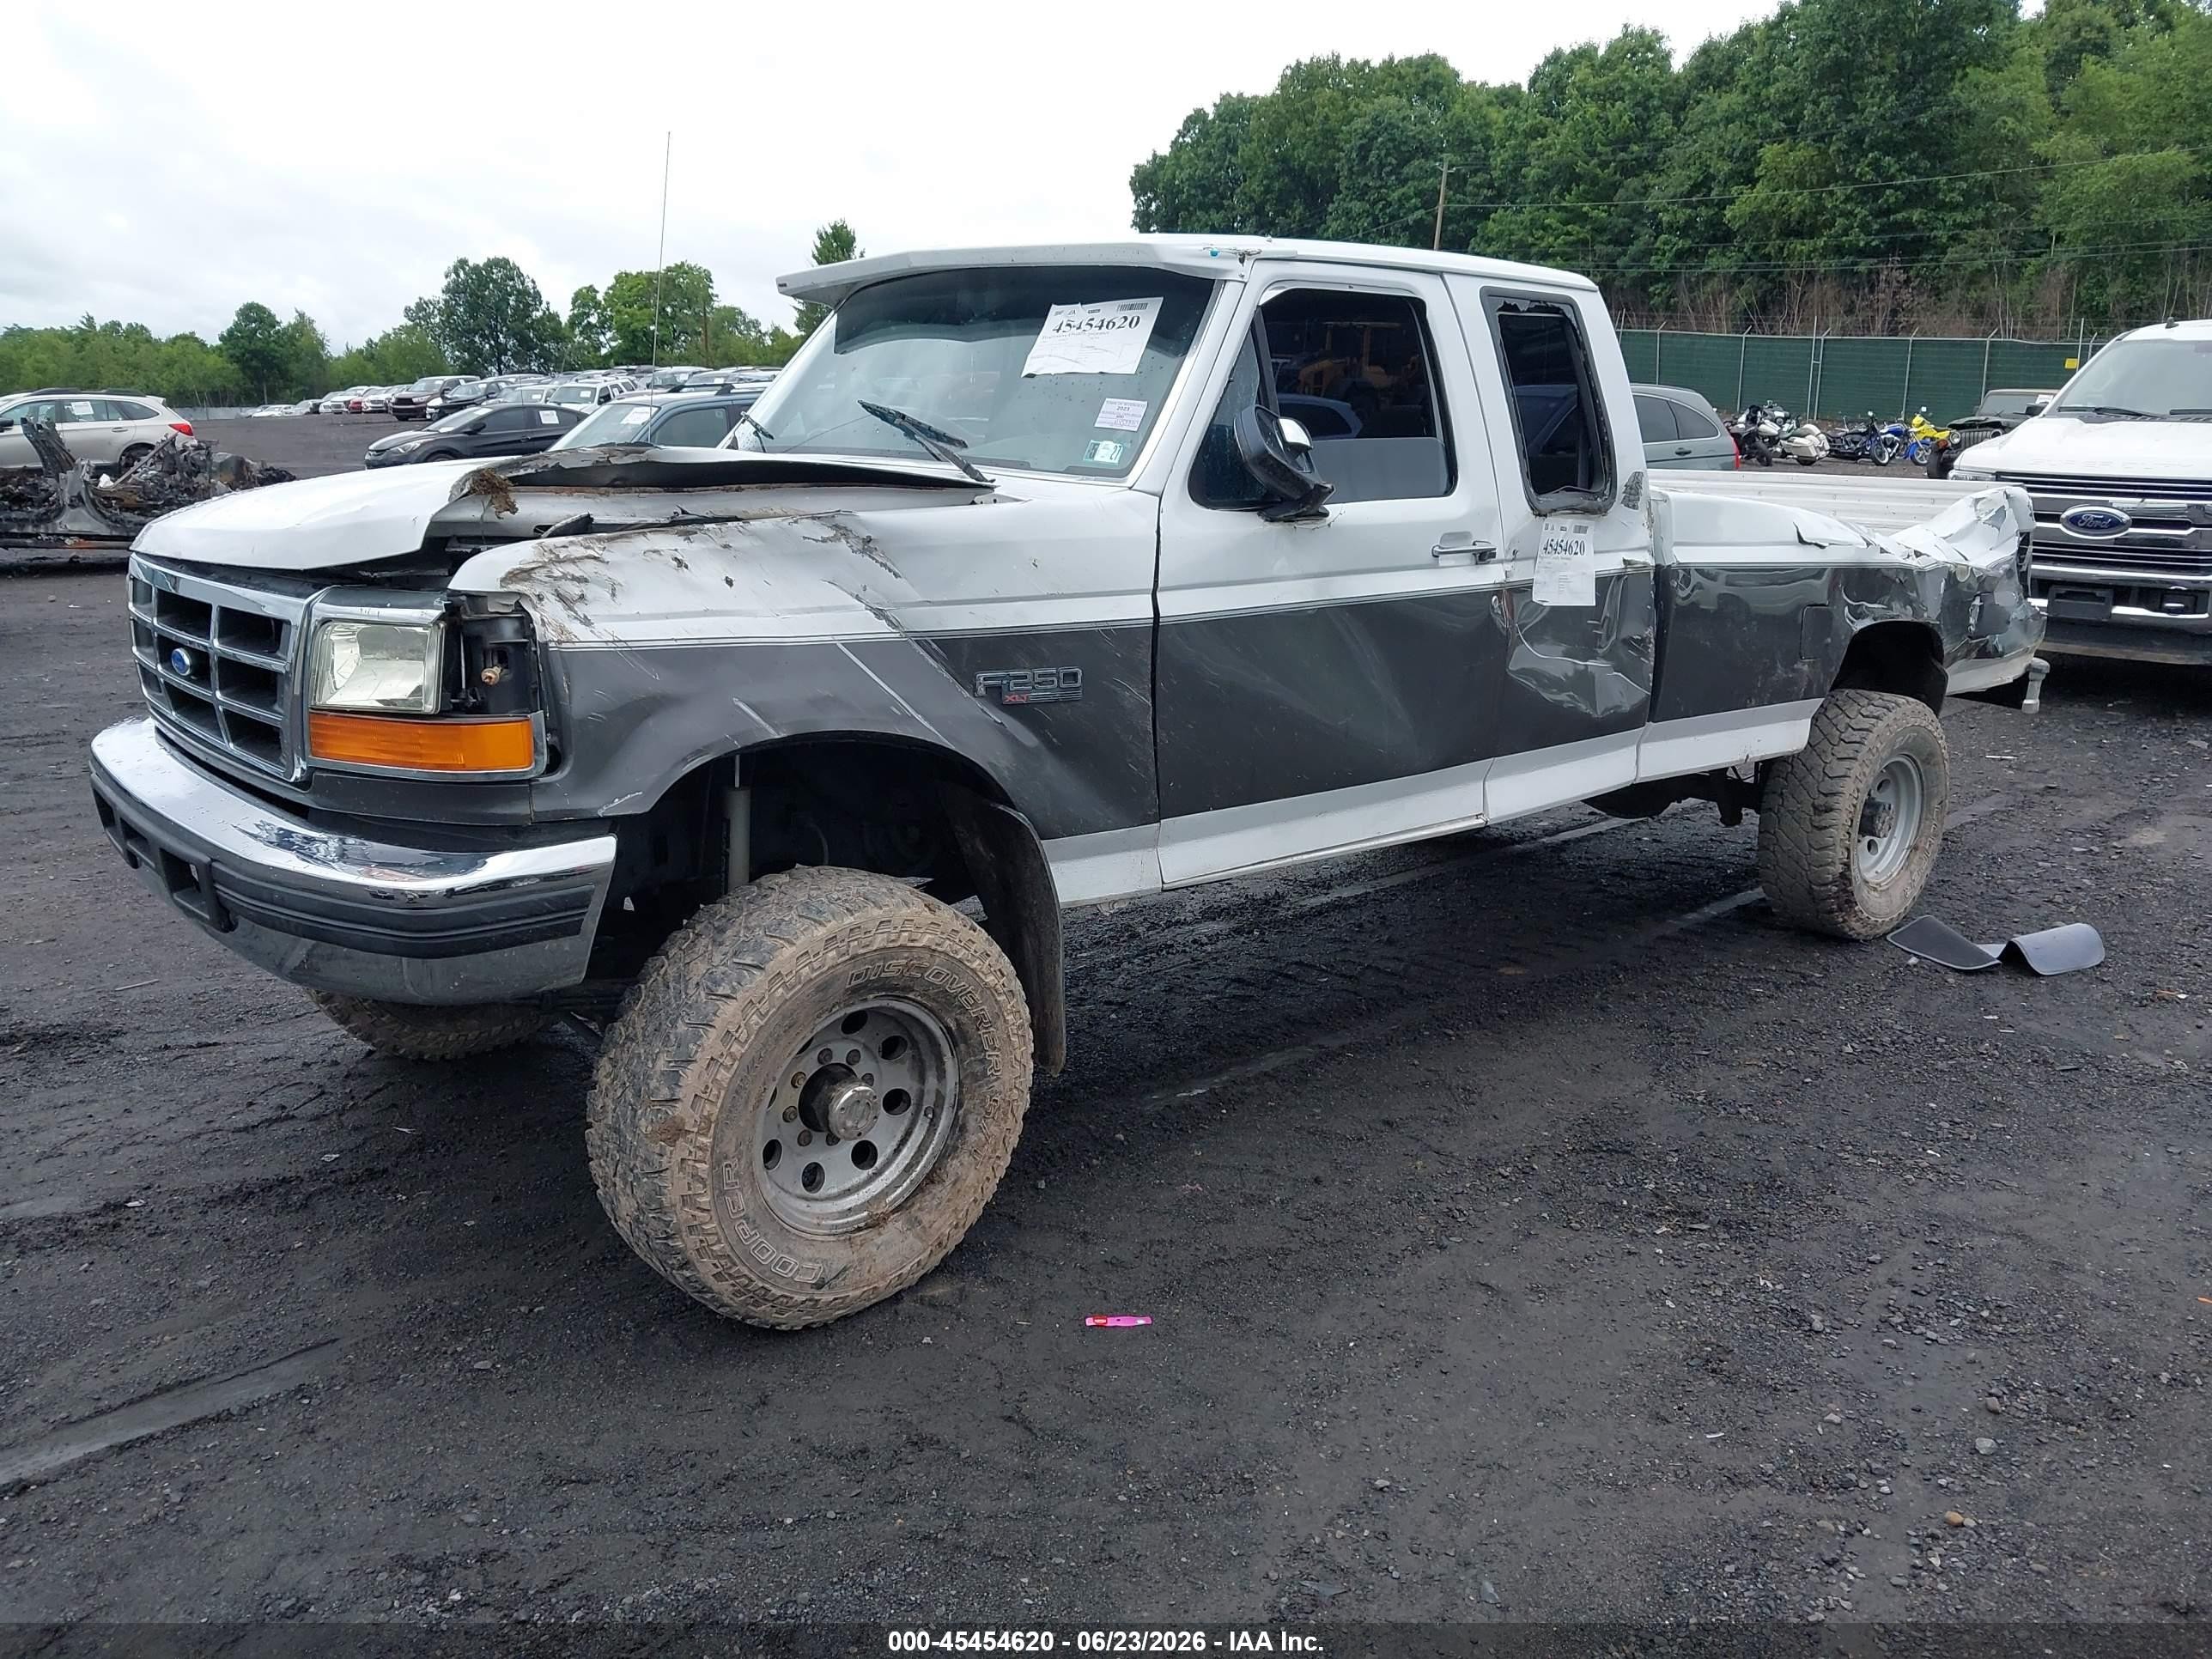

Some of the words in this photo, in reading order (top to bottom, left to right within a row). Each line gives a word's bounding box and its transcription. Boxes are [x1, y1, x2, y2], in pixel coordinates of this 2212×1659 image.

[1052, 315, 1141, 333] 45454620
[2076, 514, 2112, 529] Ford
[1543, 538, 1585, 556] 45454620
[974, 666, 1083, 697] F250
[846, 959, 1002, 1077] DISCOVERER
[722, 1159, 823, 1284] COOPER
